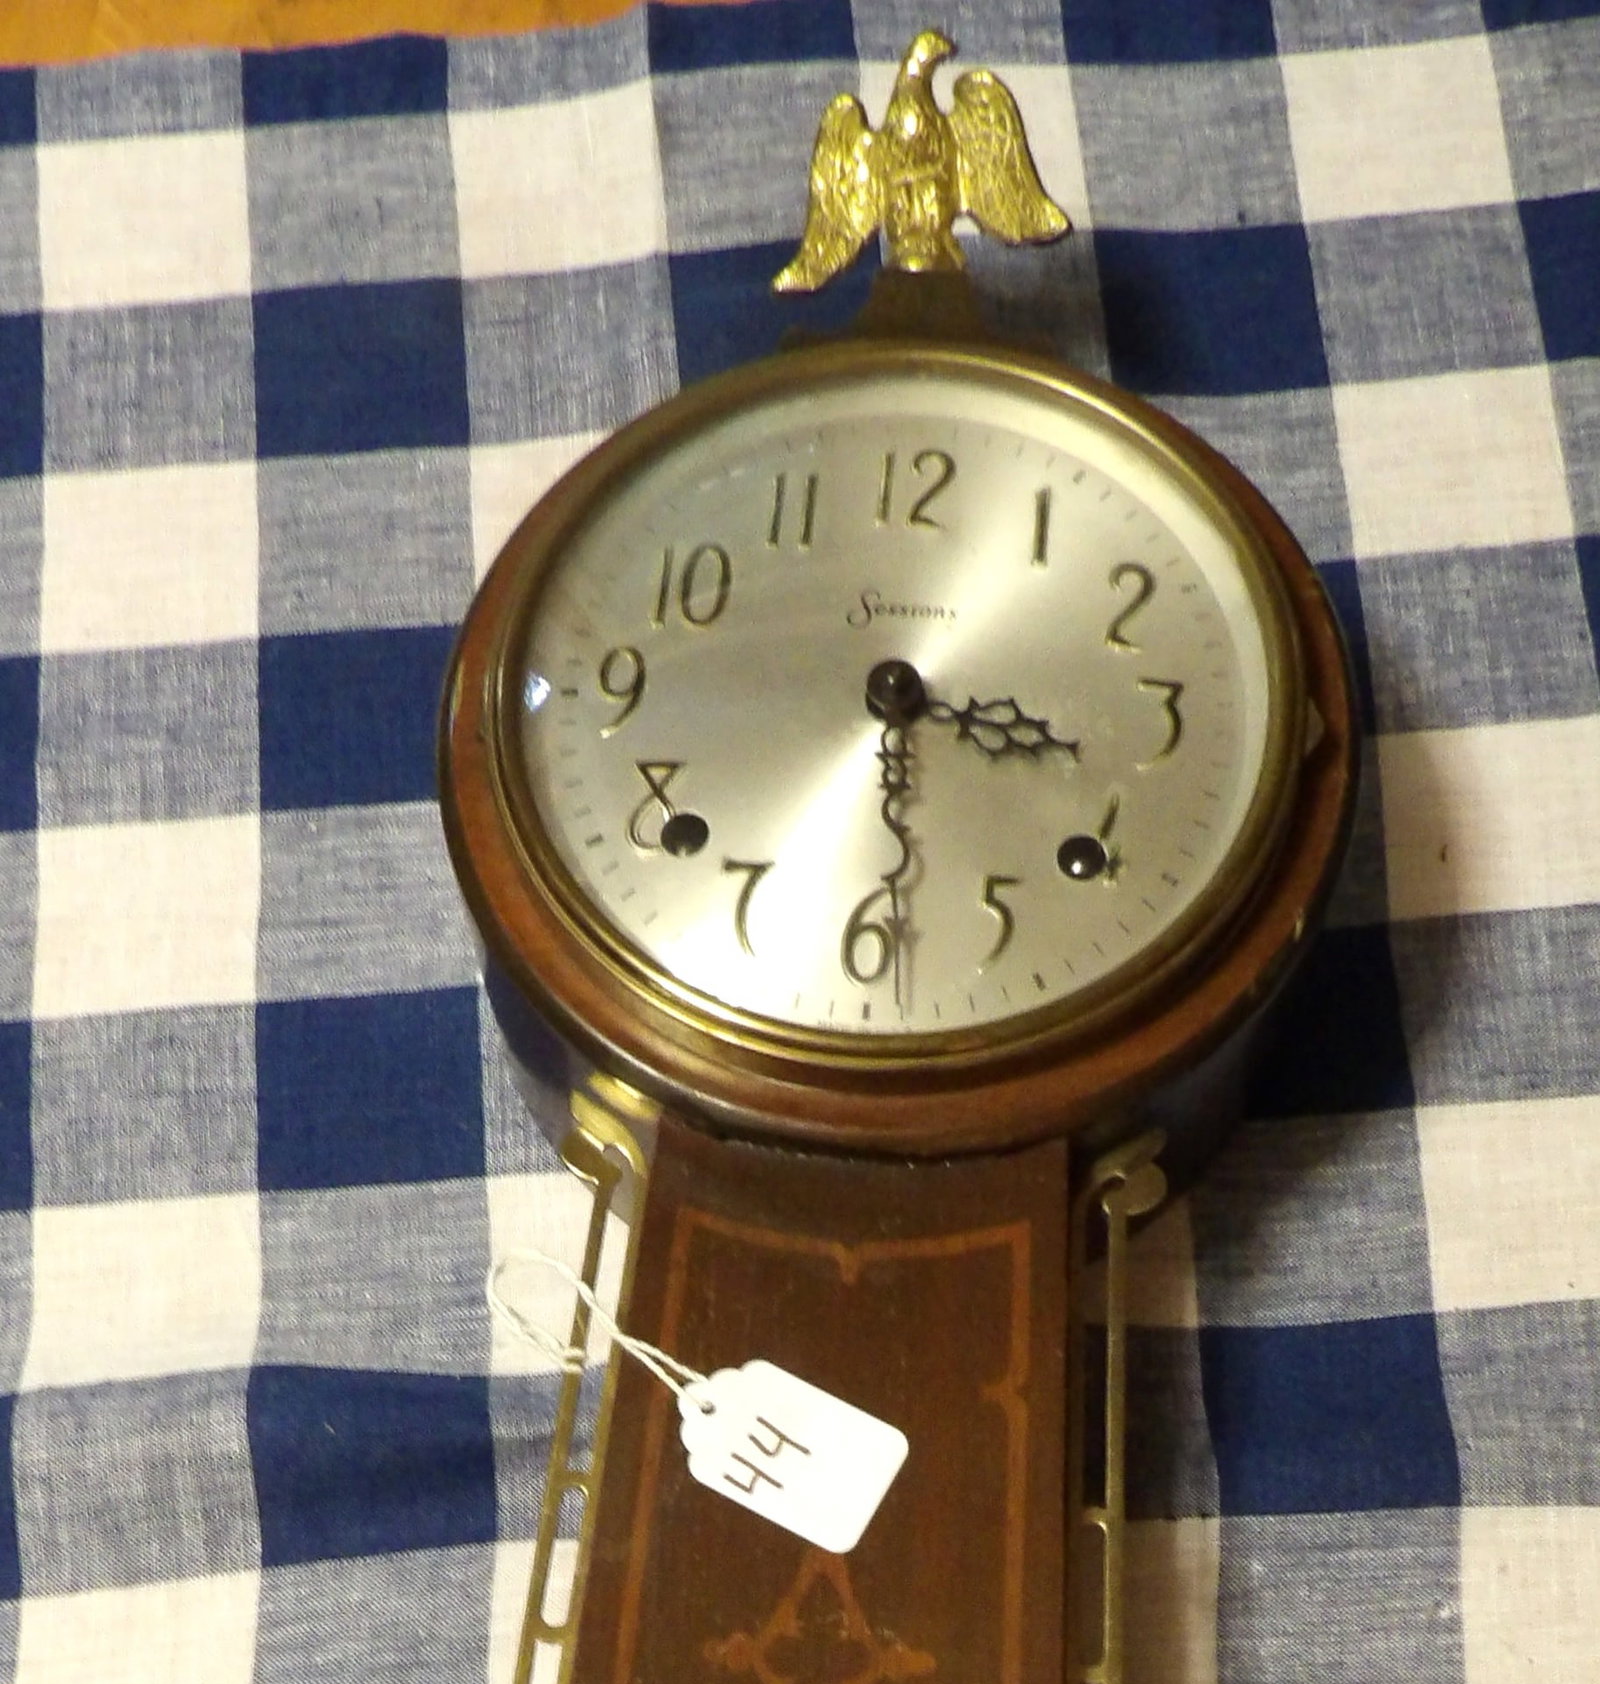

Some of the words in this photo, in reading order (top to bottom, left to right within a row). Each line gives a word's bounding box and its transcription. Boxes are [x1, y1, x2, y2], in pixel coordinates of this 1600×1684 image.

[766, 472, 819, 549] 11
[875, 450, 956, 531] 12
[1030, 486, 1051, 568] 1
[650, 545, 732, 629] 10
[846, 589, 957, 629] Sessions
[1104, 562, 1158, 653] 2
[599, 646, 647, 739] 9
[1136, 678, 1186, 771] 3
[722, 859, 776, 957] 7
[841, 884, 895, 986] 6
[977, 874, 1023, 974] 5
[722, 1415, 812, 1494] 44
